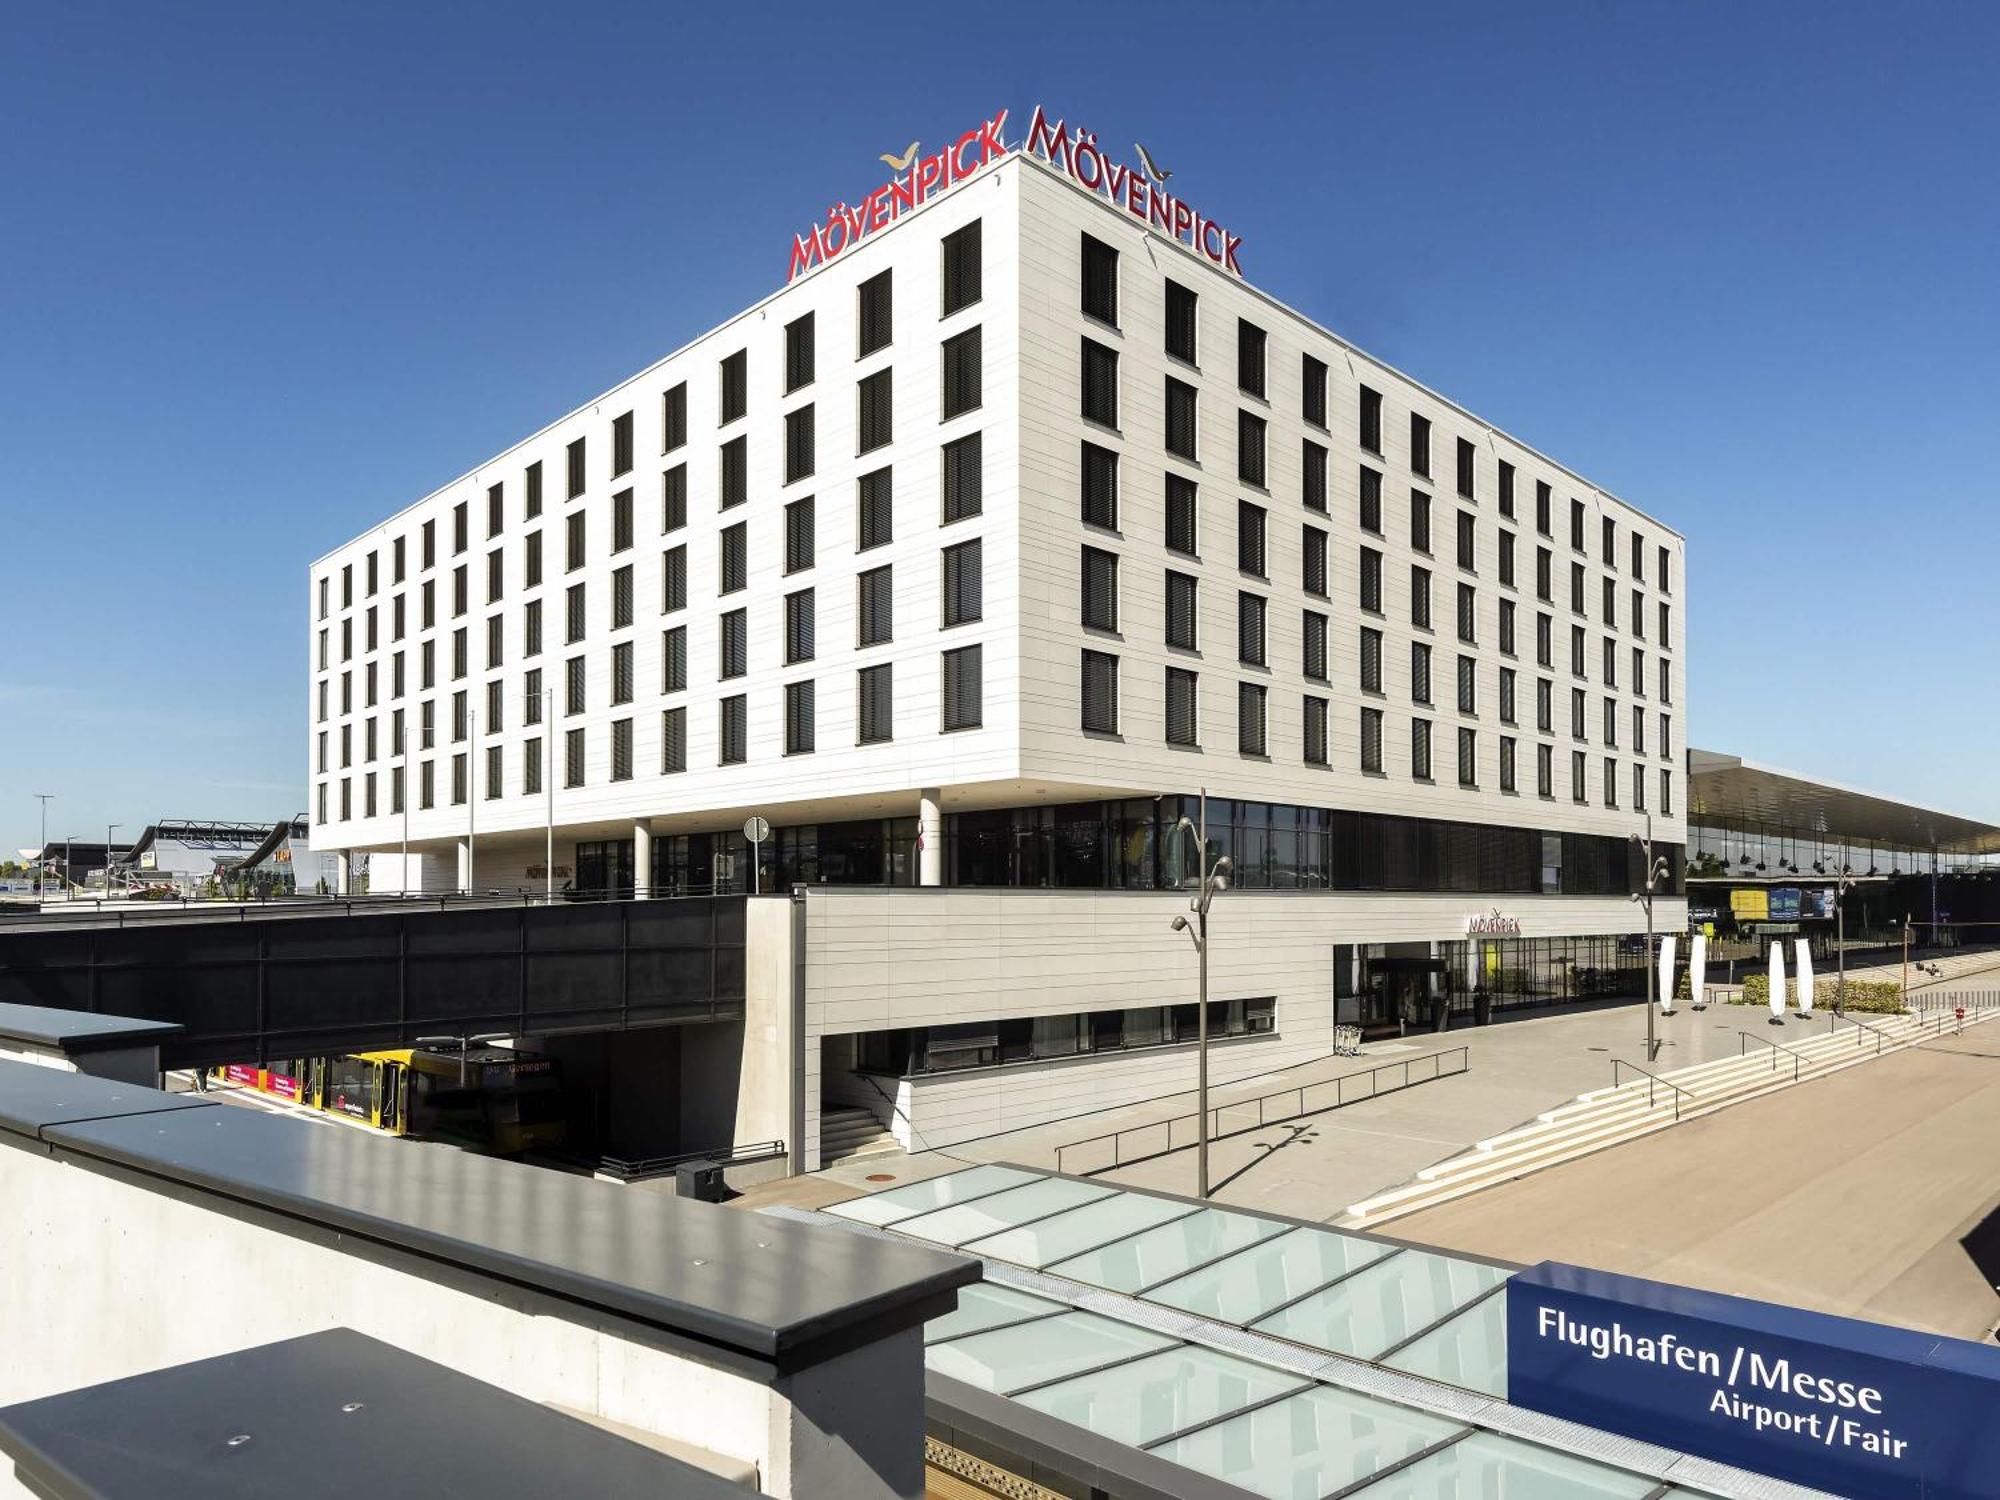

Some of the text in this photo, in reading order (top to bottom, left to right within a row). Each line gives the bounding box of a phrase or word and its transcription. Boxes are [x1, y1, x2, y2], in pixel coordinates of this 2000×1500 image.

[788, 108, 1009, 283] MÖVENPICK
[1026, 105, 1243, 276] MÖVENPICK
[1709, 1389, 1908, 1458] Airport/Fair
